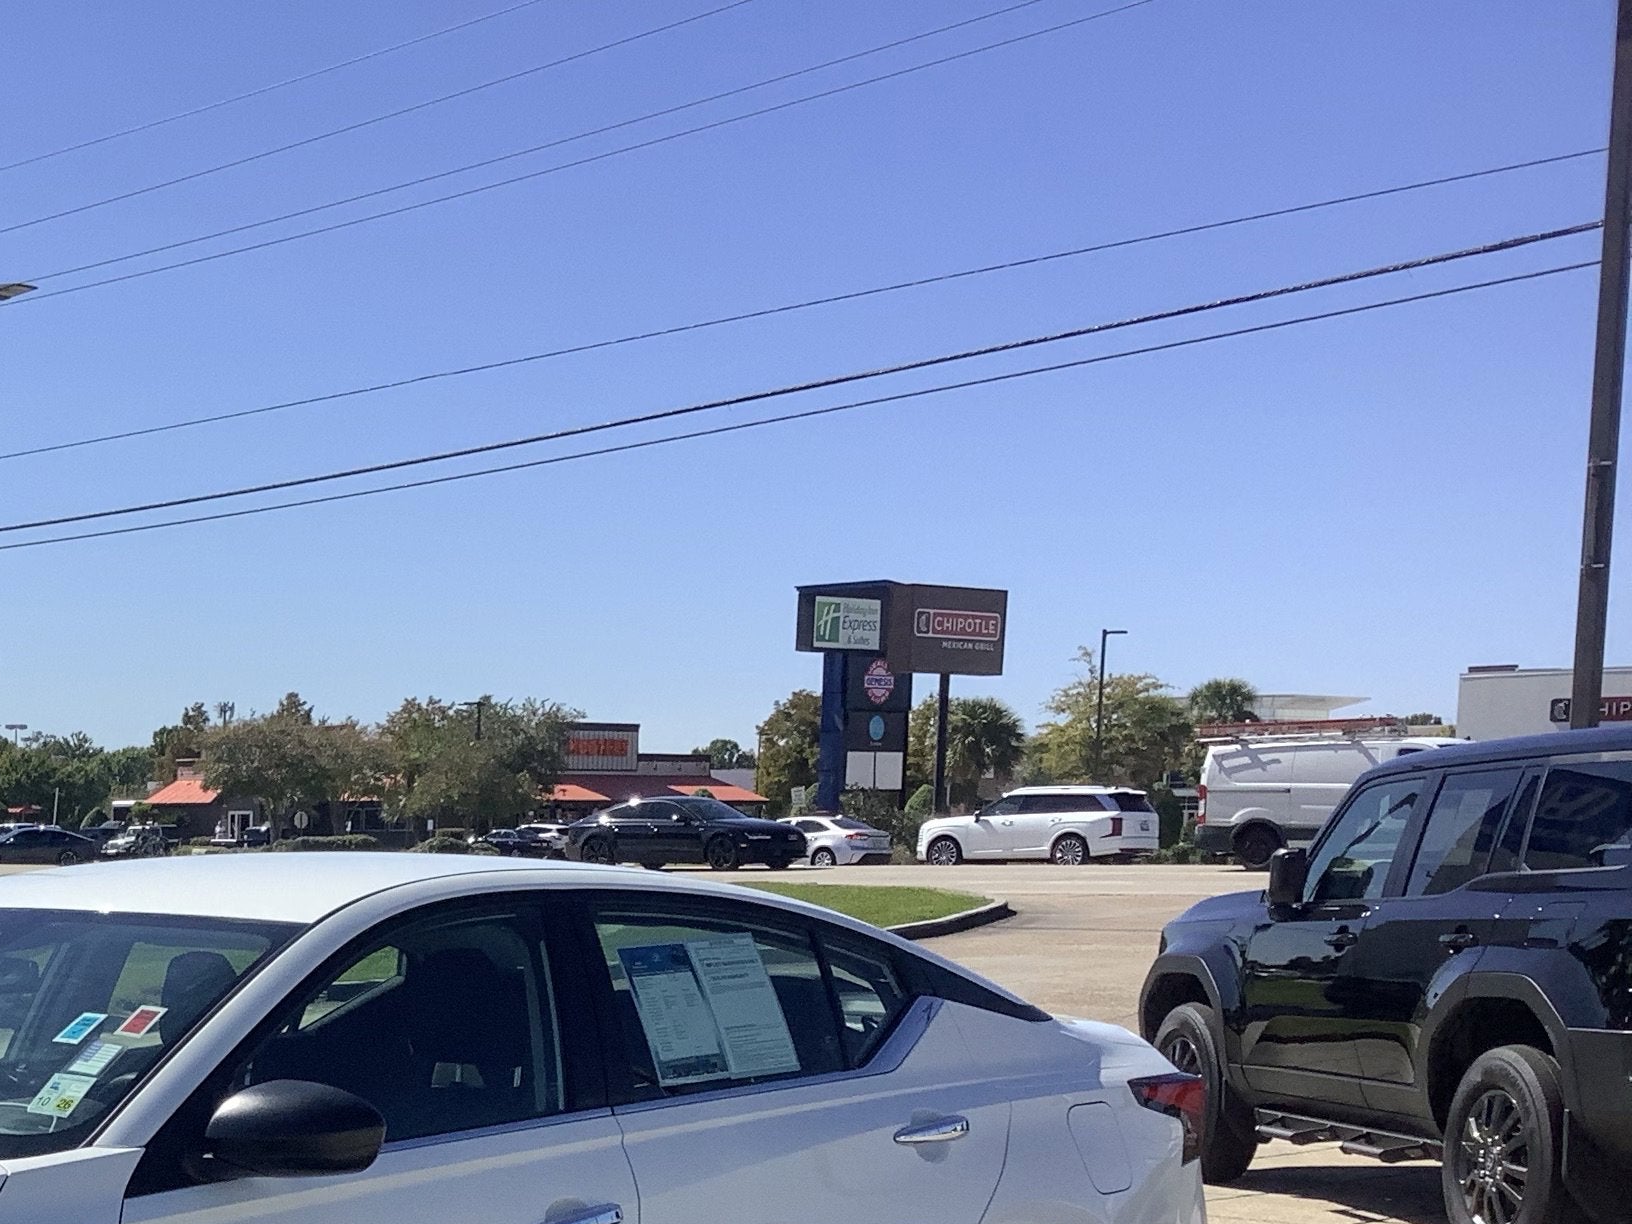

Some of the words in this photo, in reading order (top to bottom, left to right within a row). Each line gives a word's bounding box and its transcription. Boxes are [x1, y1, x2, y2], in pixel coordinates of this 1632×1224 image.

[842, 615, 877, 634] Express
[934, 616, 997, 634] CHIPOTLE
[941, 641, 973, 651] MEXICAN
[55, 1097, 74, 1110] 26
